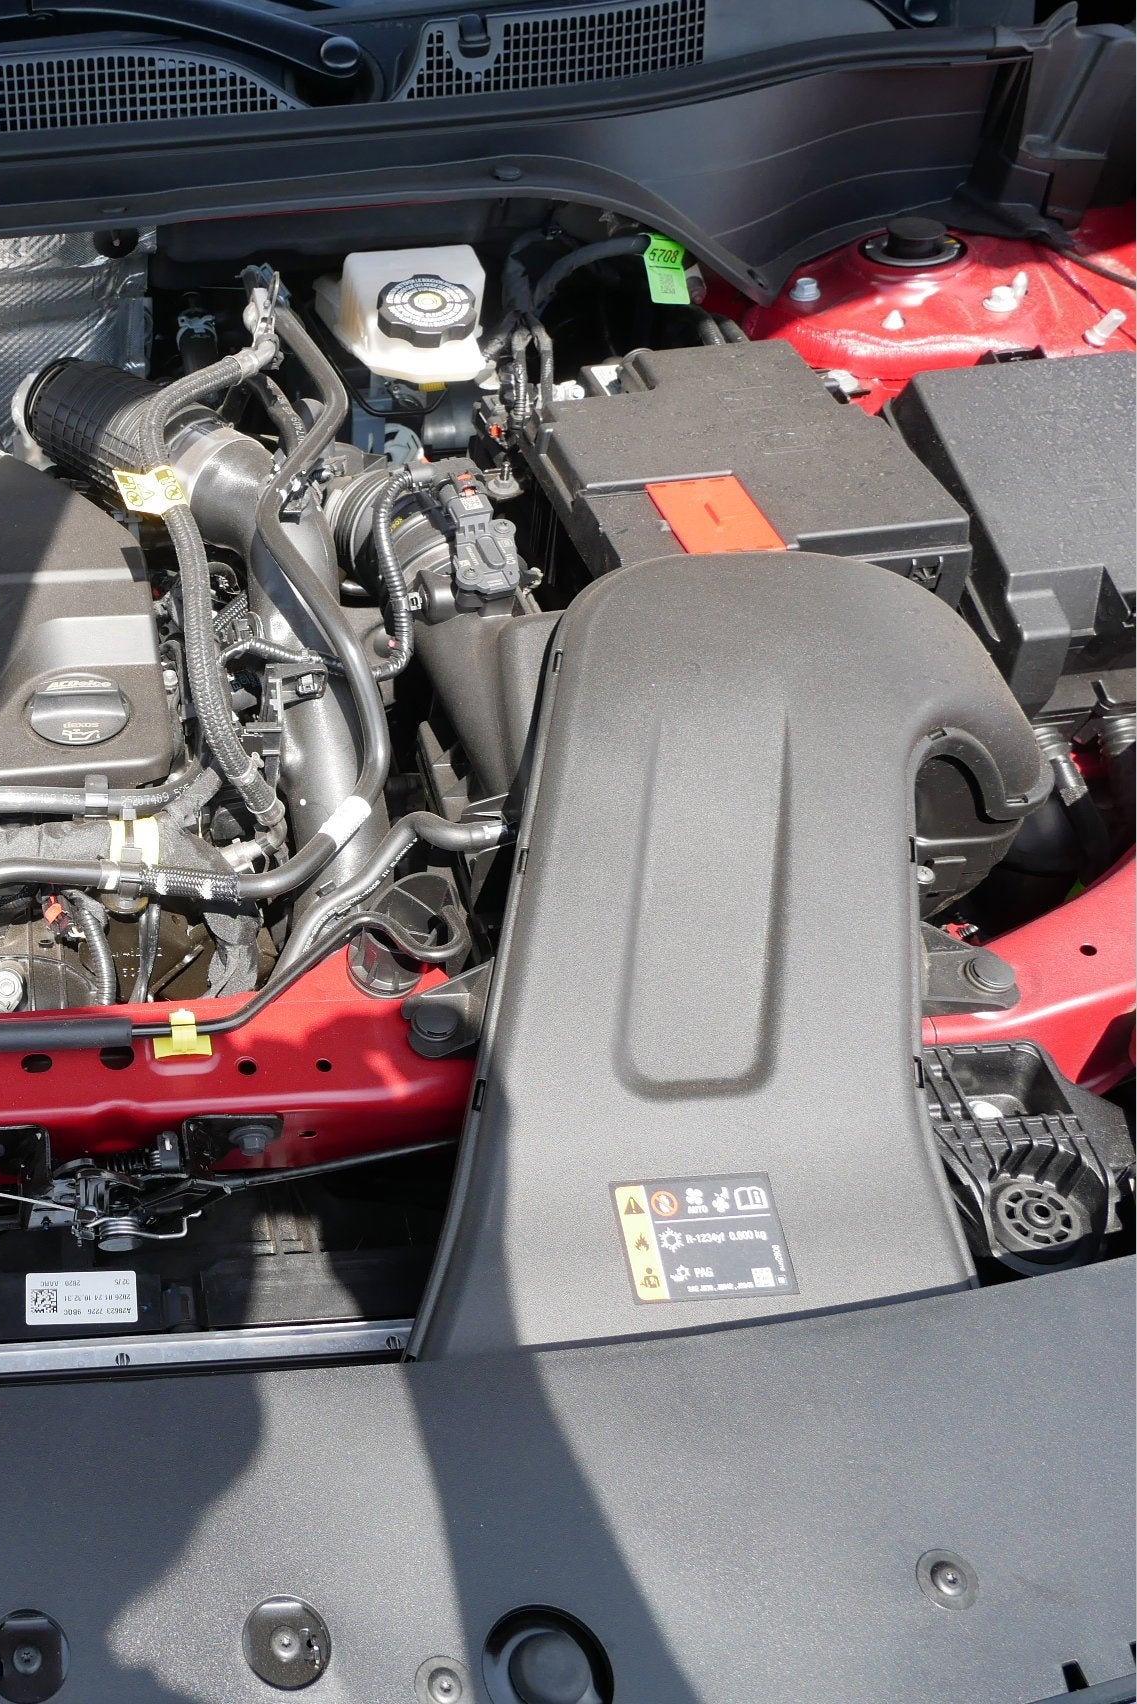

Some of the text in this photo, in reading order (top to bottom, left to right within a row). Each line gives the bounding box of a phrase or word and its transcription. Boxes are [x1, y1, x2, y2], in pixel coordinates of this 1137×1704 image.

[648, 248, 680, 264] 5708
[46, 679, 112, 691] ACDelco
[63, 721, 100, 729] dexos
[687, 1205, 709, 1214] AUTO
[693, 1266, 715, 1279] PAG
